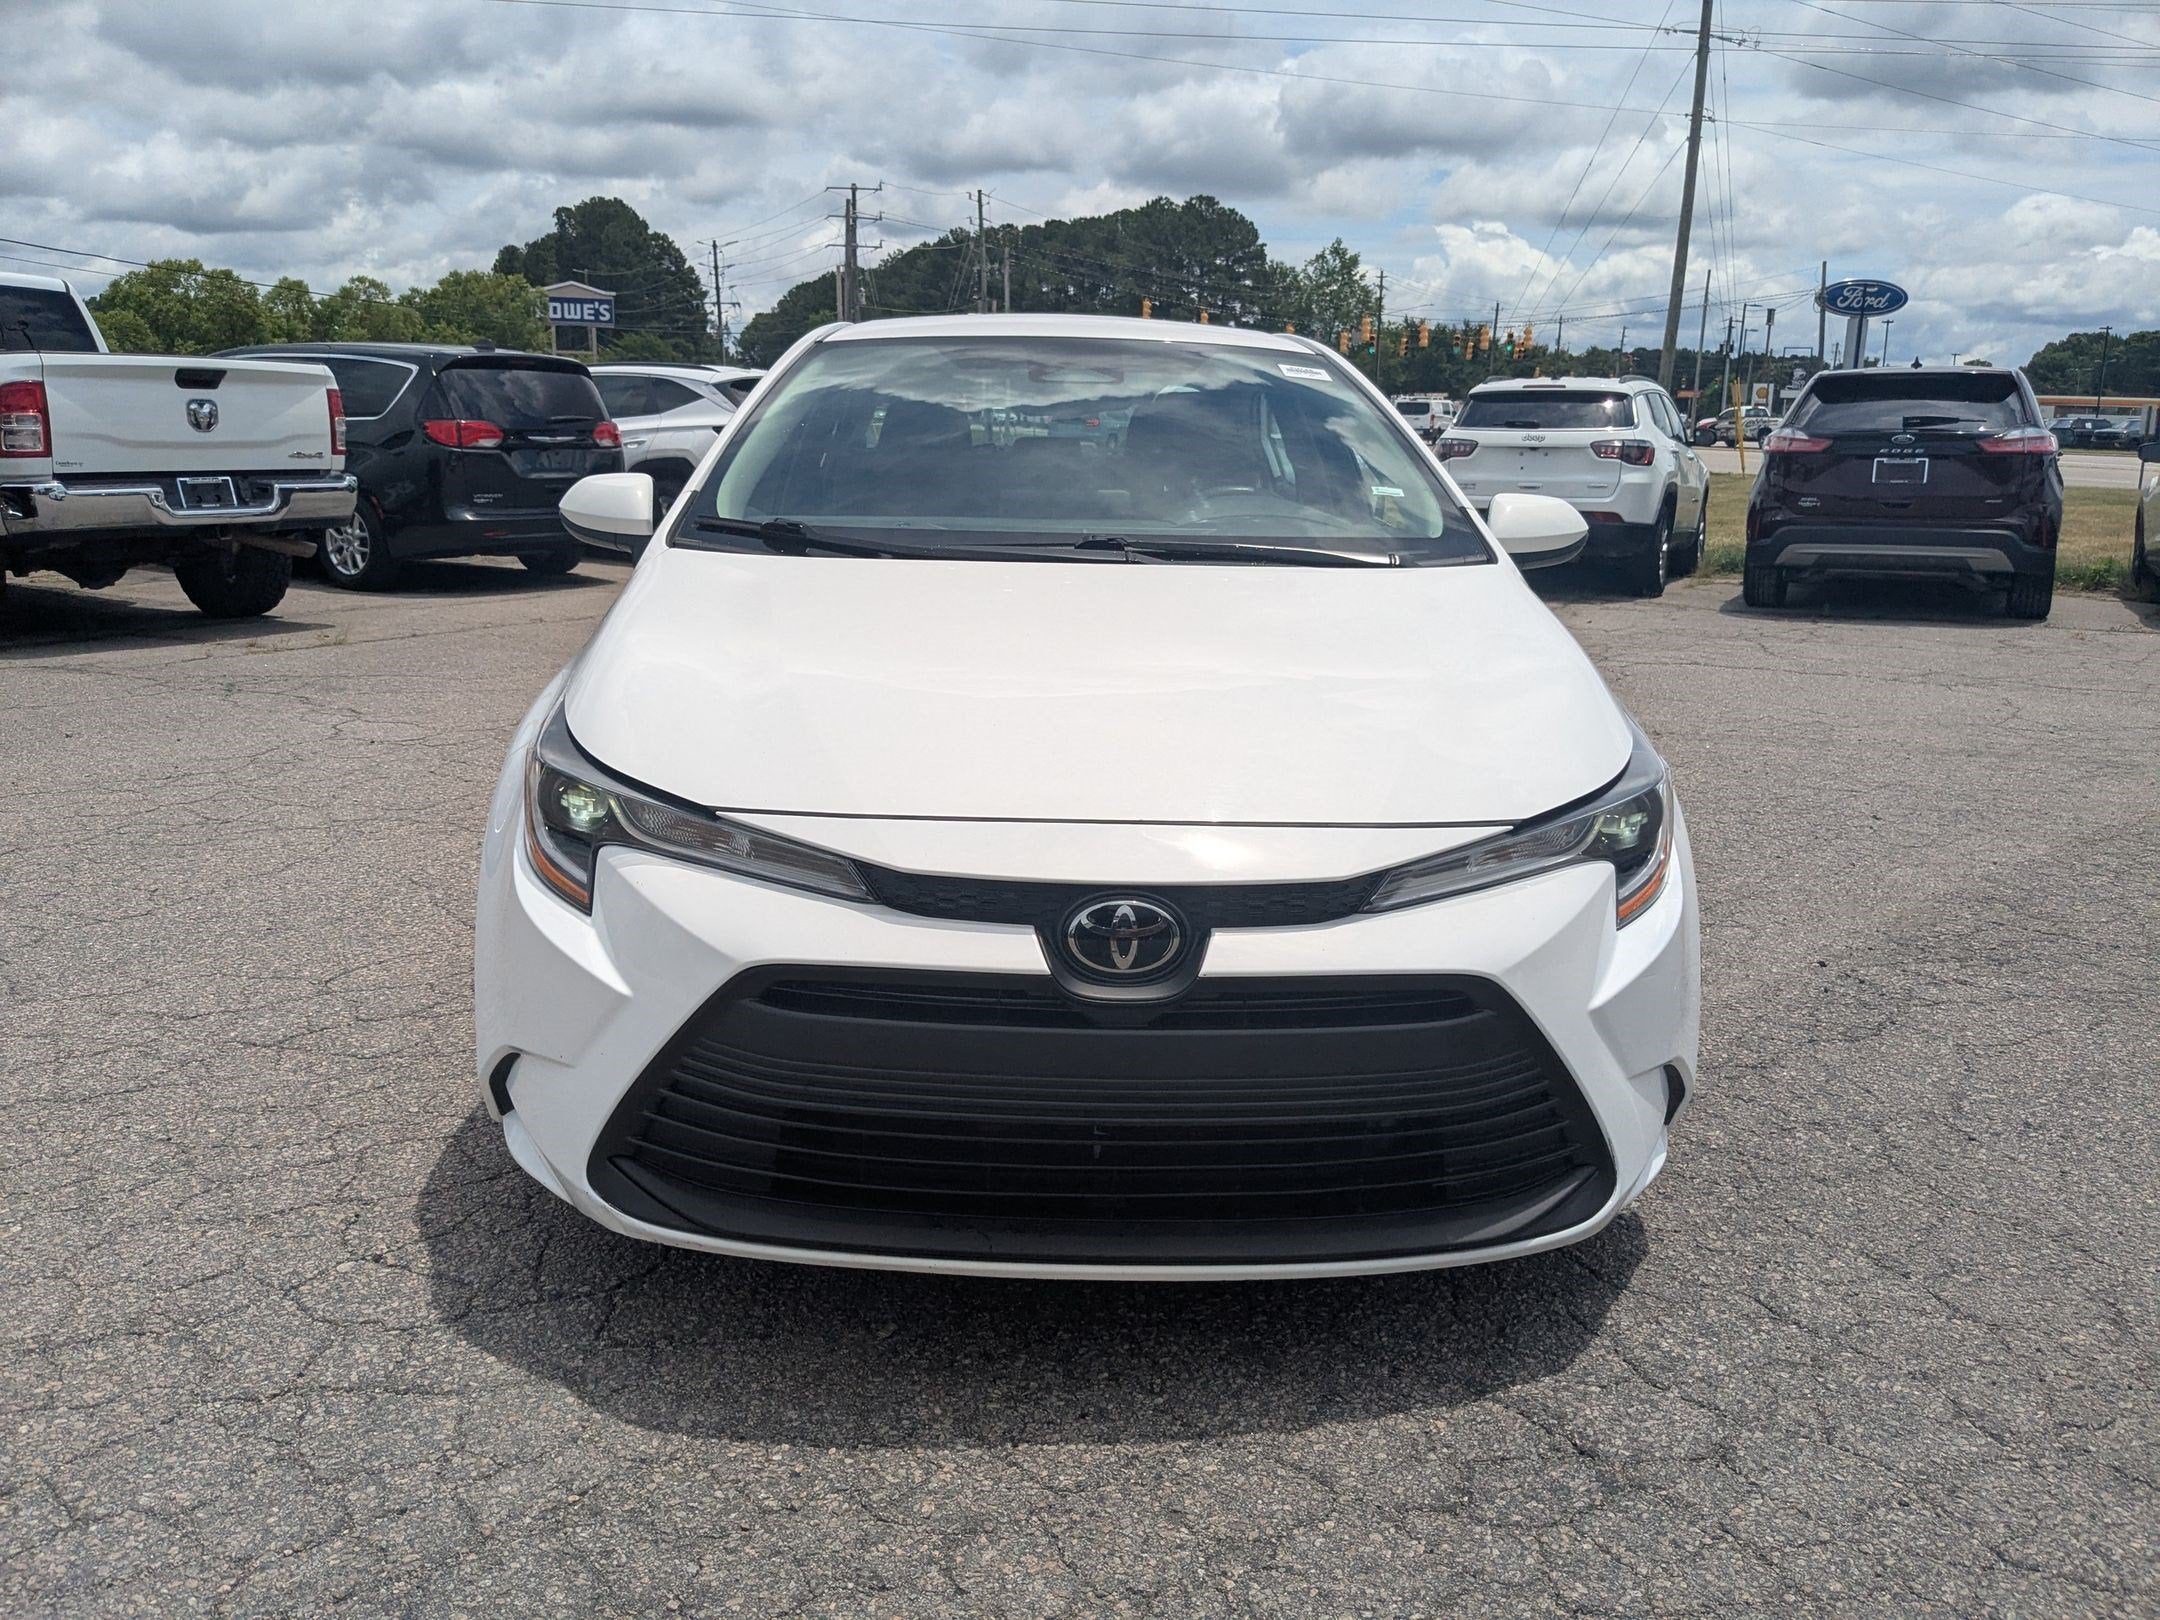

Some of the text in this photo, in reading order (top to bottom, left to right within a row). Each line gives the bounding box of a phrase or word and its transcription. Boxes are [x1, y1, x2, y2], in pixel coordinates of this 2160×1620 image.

[1837, 286, 1890, 309] Ford
[537, 301, 611, 321] OWE'S
[1521, 433, 1546, 443] Jeep
